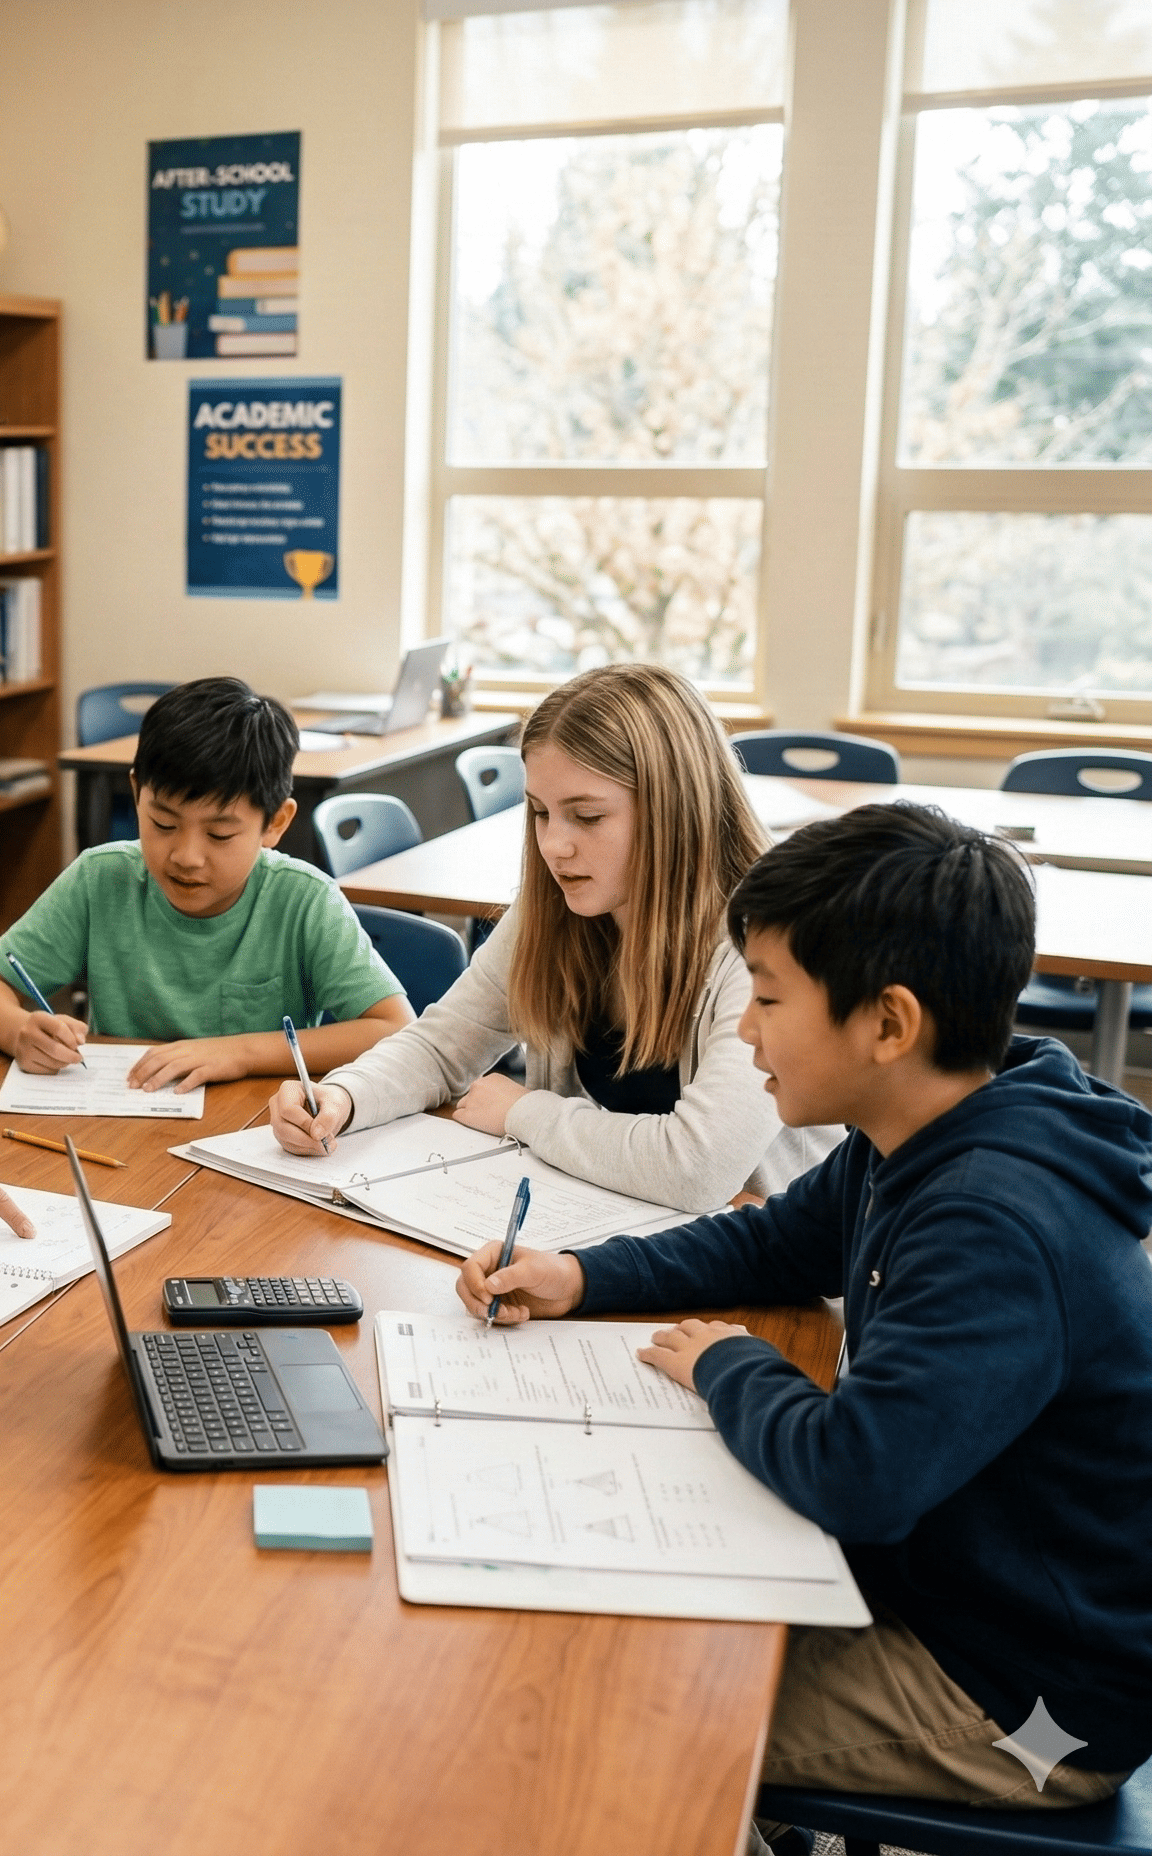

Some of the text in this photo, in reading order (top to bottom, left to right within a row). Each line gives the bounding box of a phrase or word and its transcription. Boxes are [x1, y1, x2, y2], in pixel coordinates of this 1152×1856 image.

[180, 187, 268, 219] STUDY
[192, 400, 335, 430] ACADEMIC
[204, 432, 323, 460] SUCCESS
